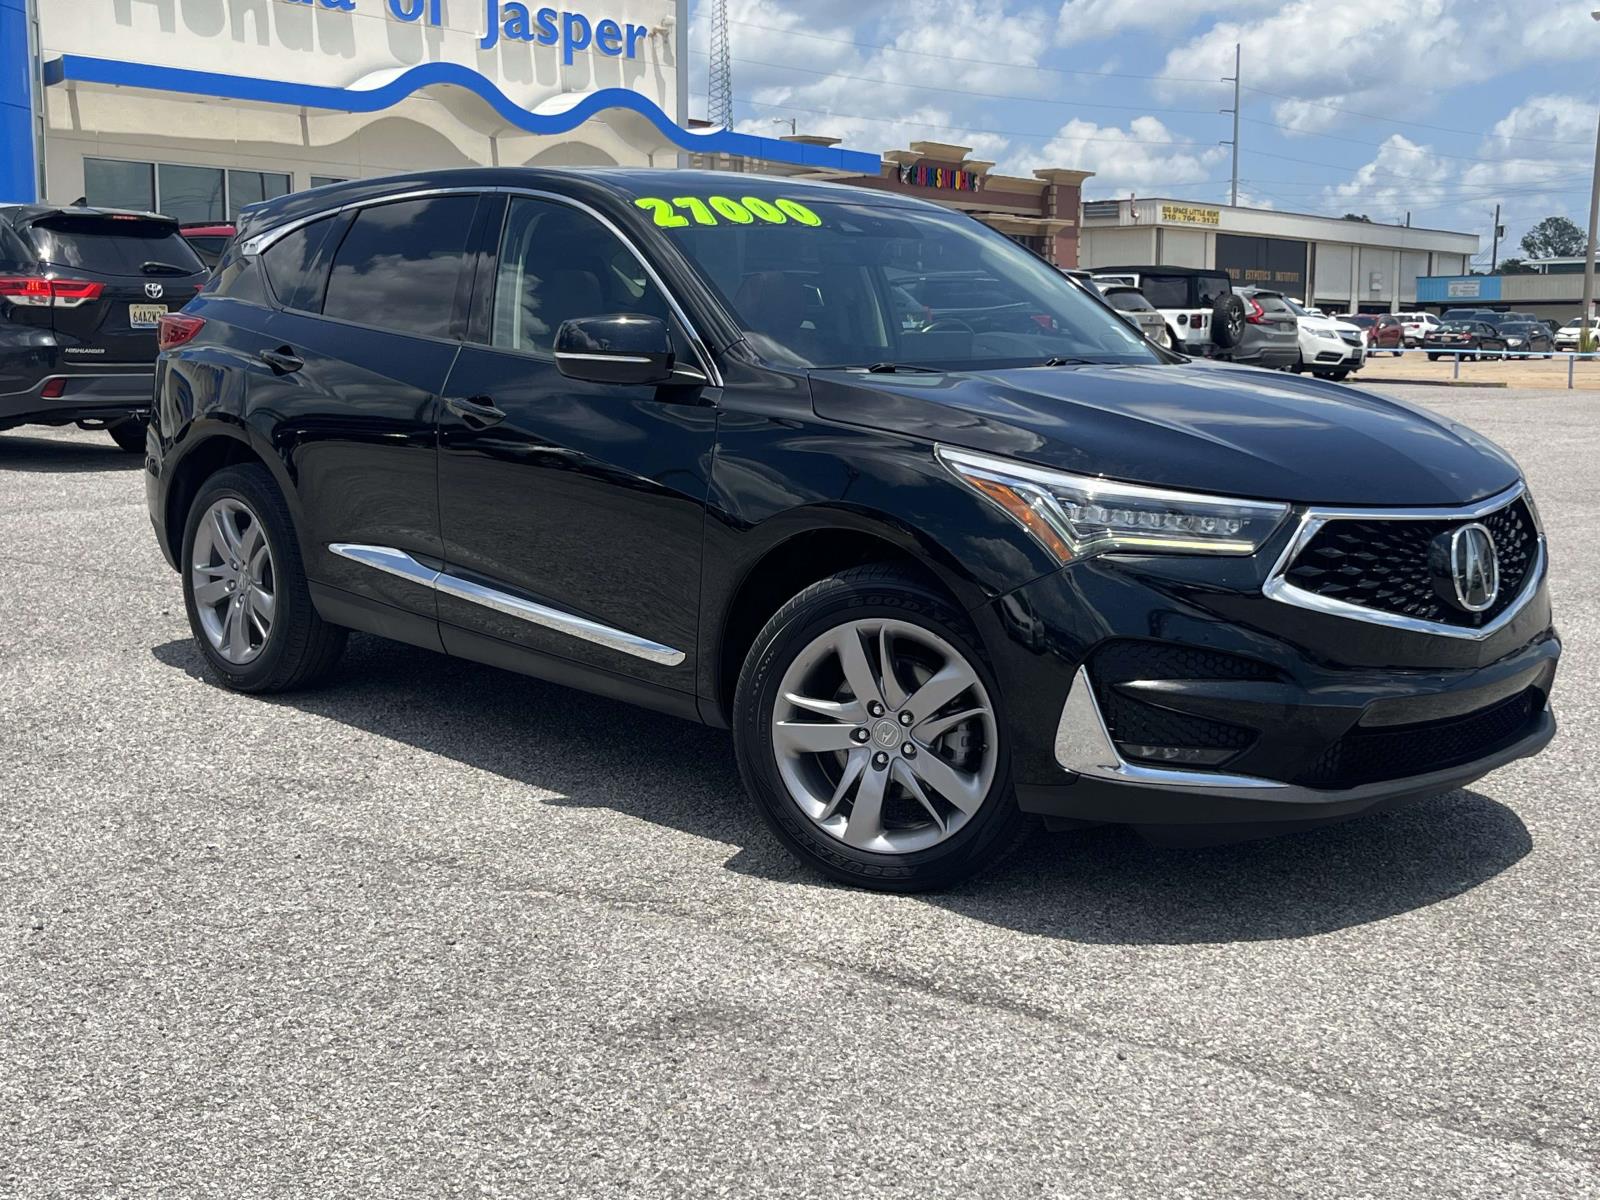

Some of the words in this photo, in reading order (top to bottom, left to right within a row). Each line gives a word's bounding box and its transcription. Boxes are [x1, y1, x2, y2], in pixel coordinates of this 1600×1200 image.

[480, 0, 648, 65] Jasper
[635, 196, 822, 228] 27000
[1173, 207, 1188, 215] SPACE
[1189, 208, 1205, 217] LITTLE
